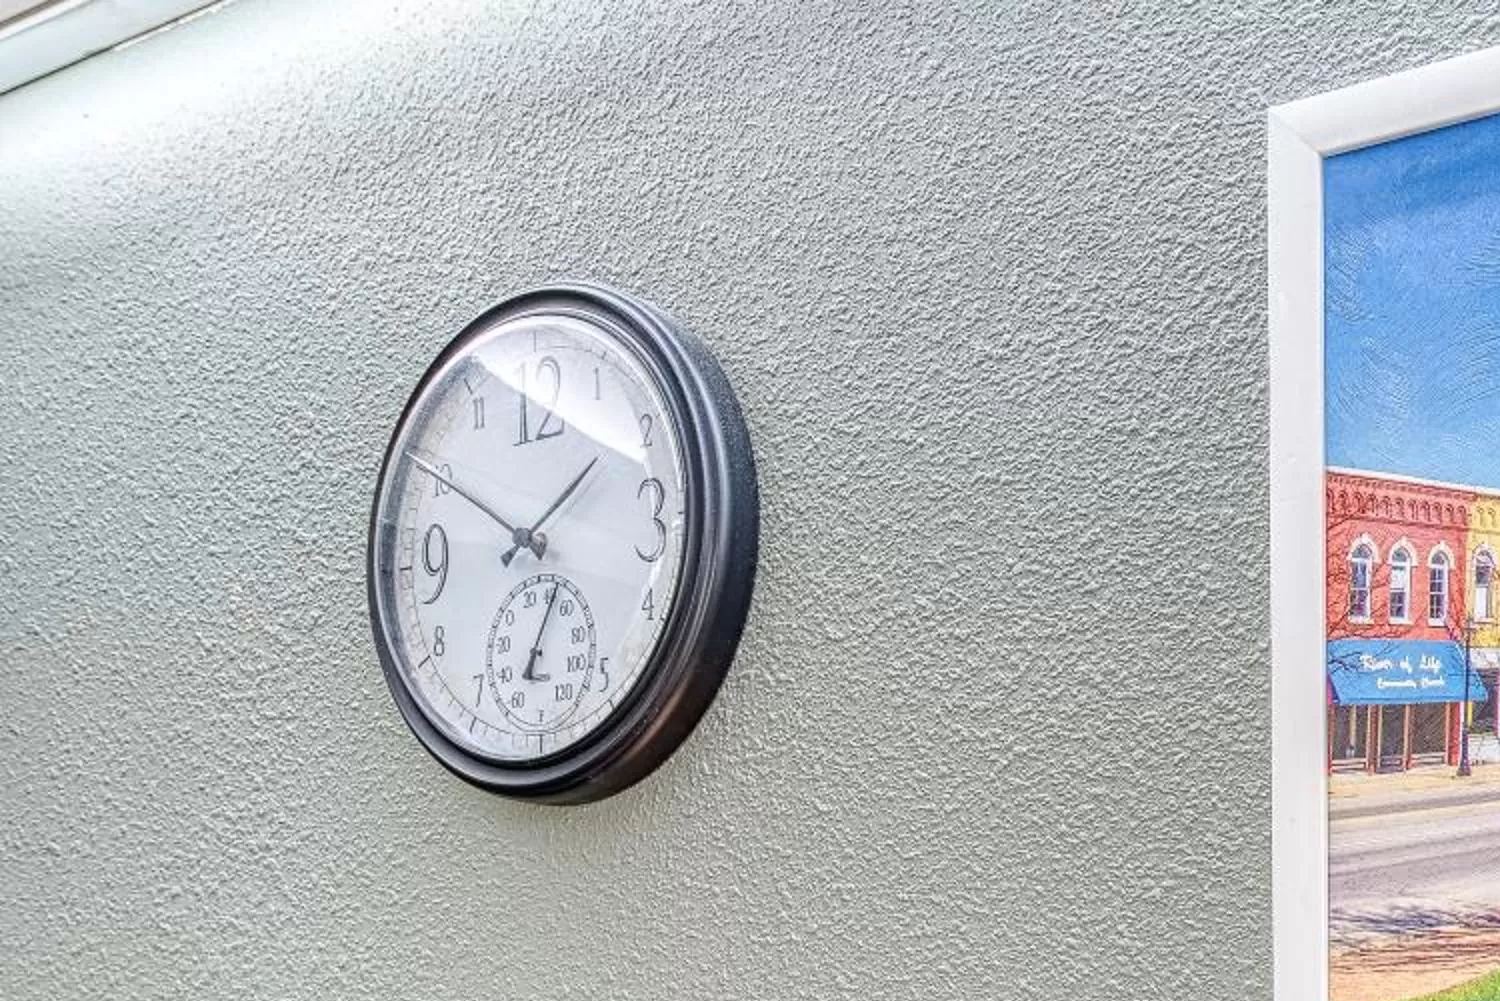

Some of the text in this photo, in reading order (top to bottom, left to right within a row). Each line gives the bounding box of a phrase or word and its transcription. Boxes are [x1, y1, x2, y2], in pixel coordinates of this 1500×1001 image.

[514, 355, 564, 446] 12
[594, 367, 601, 400] 1
[472, 393, 486, 430] 11
[639, 413, 653, 448] 2
[432, 463, 454, 498] 10
[634, 477, 667, 563] 3
[421, 523, 449, 605] 9
[505, 609, 515, 626] 0
[560, 600, 574, 617] 60
[640, 587, 655, 622] 4
[432, 626, 445, 659] 8
[571, 626, 586, 645] 80
[567, 653, 586, 673] 100
[599, 657, 609, 692] 5
[473, 673, 484, 708] 7
